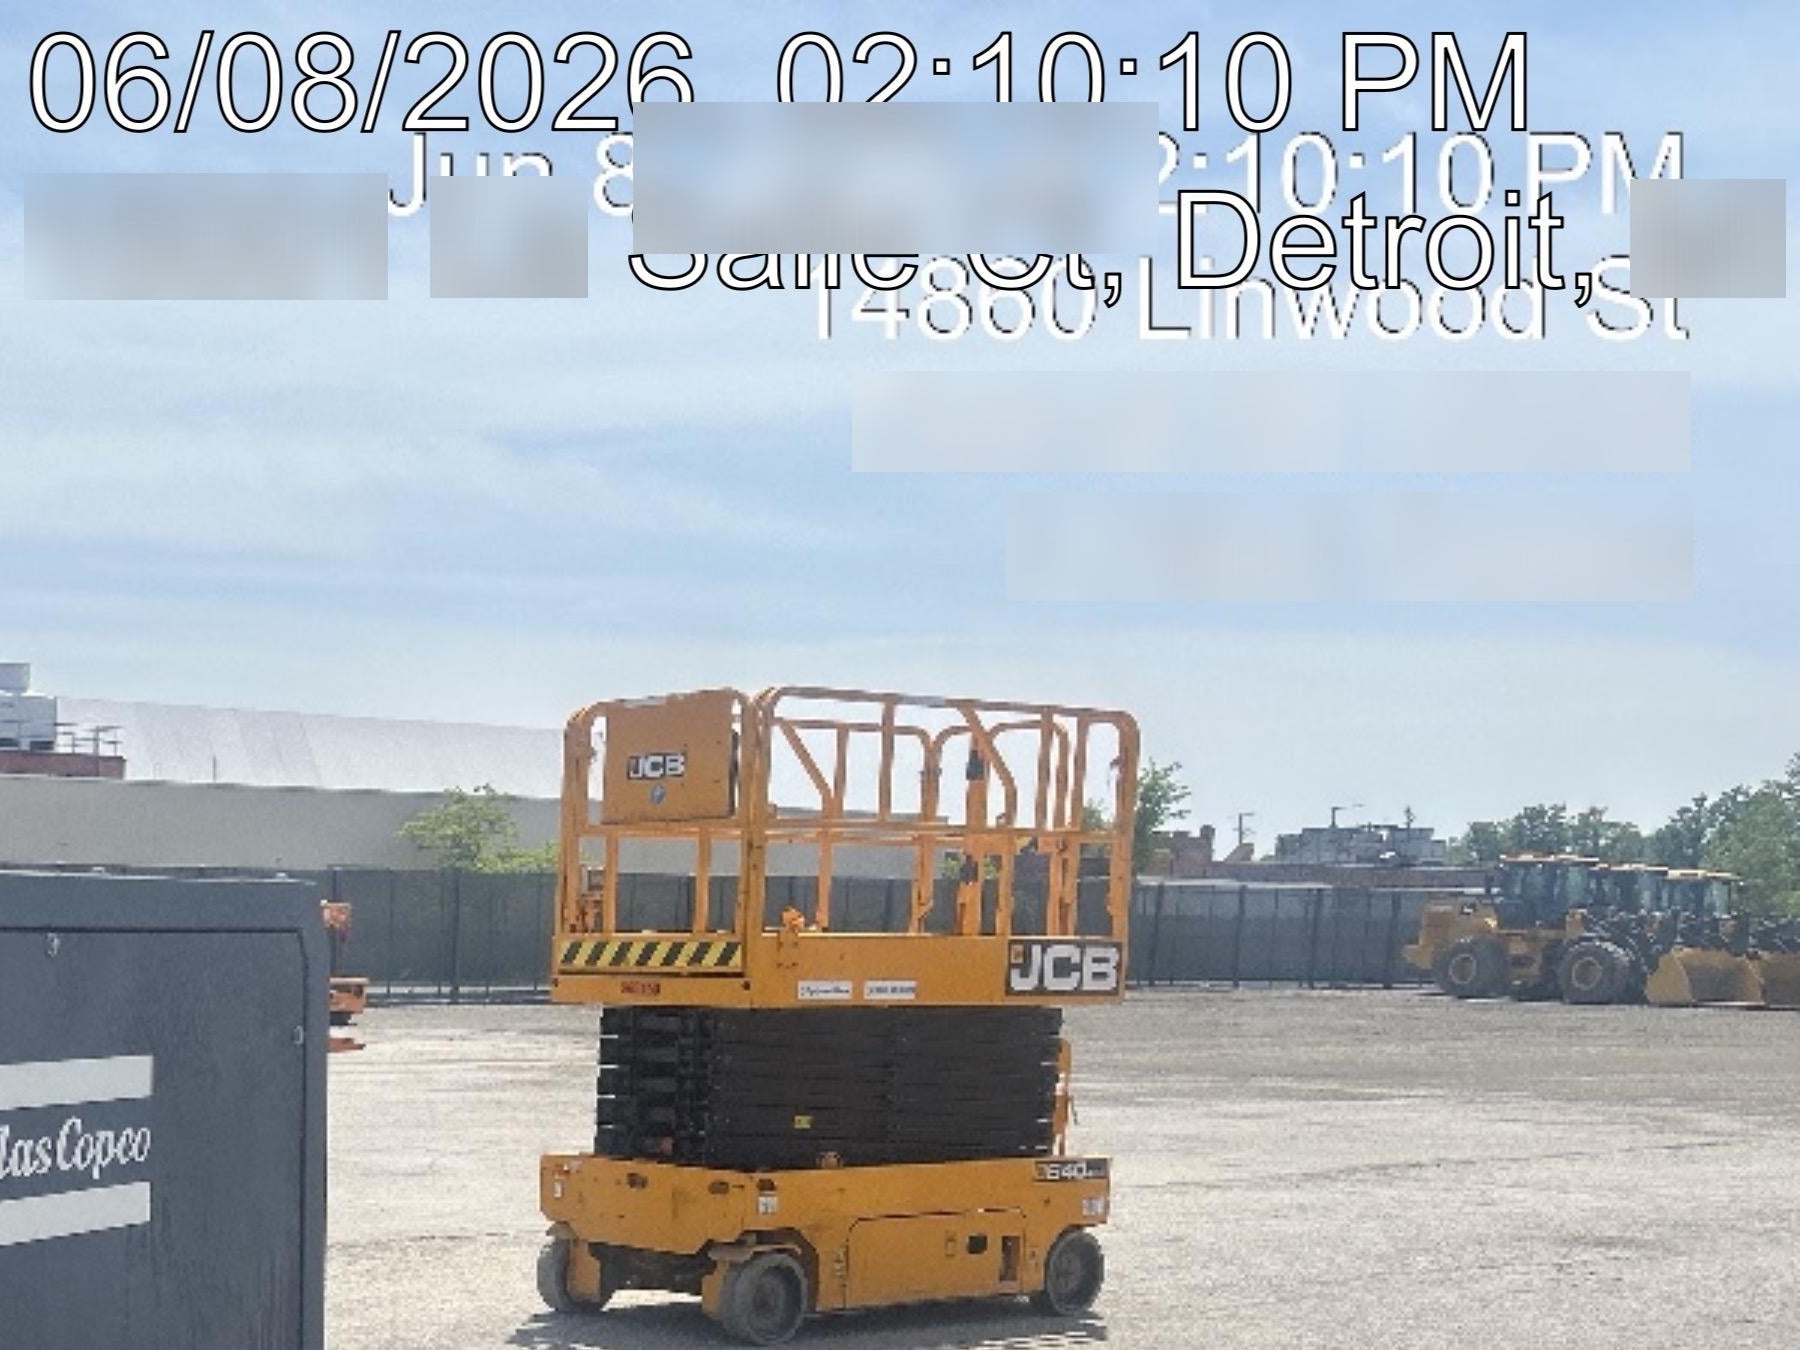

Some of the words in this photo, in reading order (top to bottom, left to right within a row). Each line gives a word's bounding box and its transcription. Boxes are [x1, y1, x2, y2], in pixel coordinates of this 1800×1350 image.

[629, 754, 686, 778] JCB
[1010, 943, 1119, 992] JCB
[56, 1115, 151, 1180] Copco
